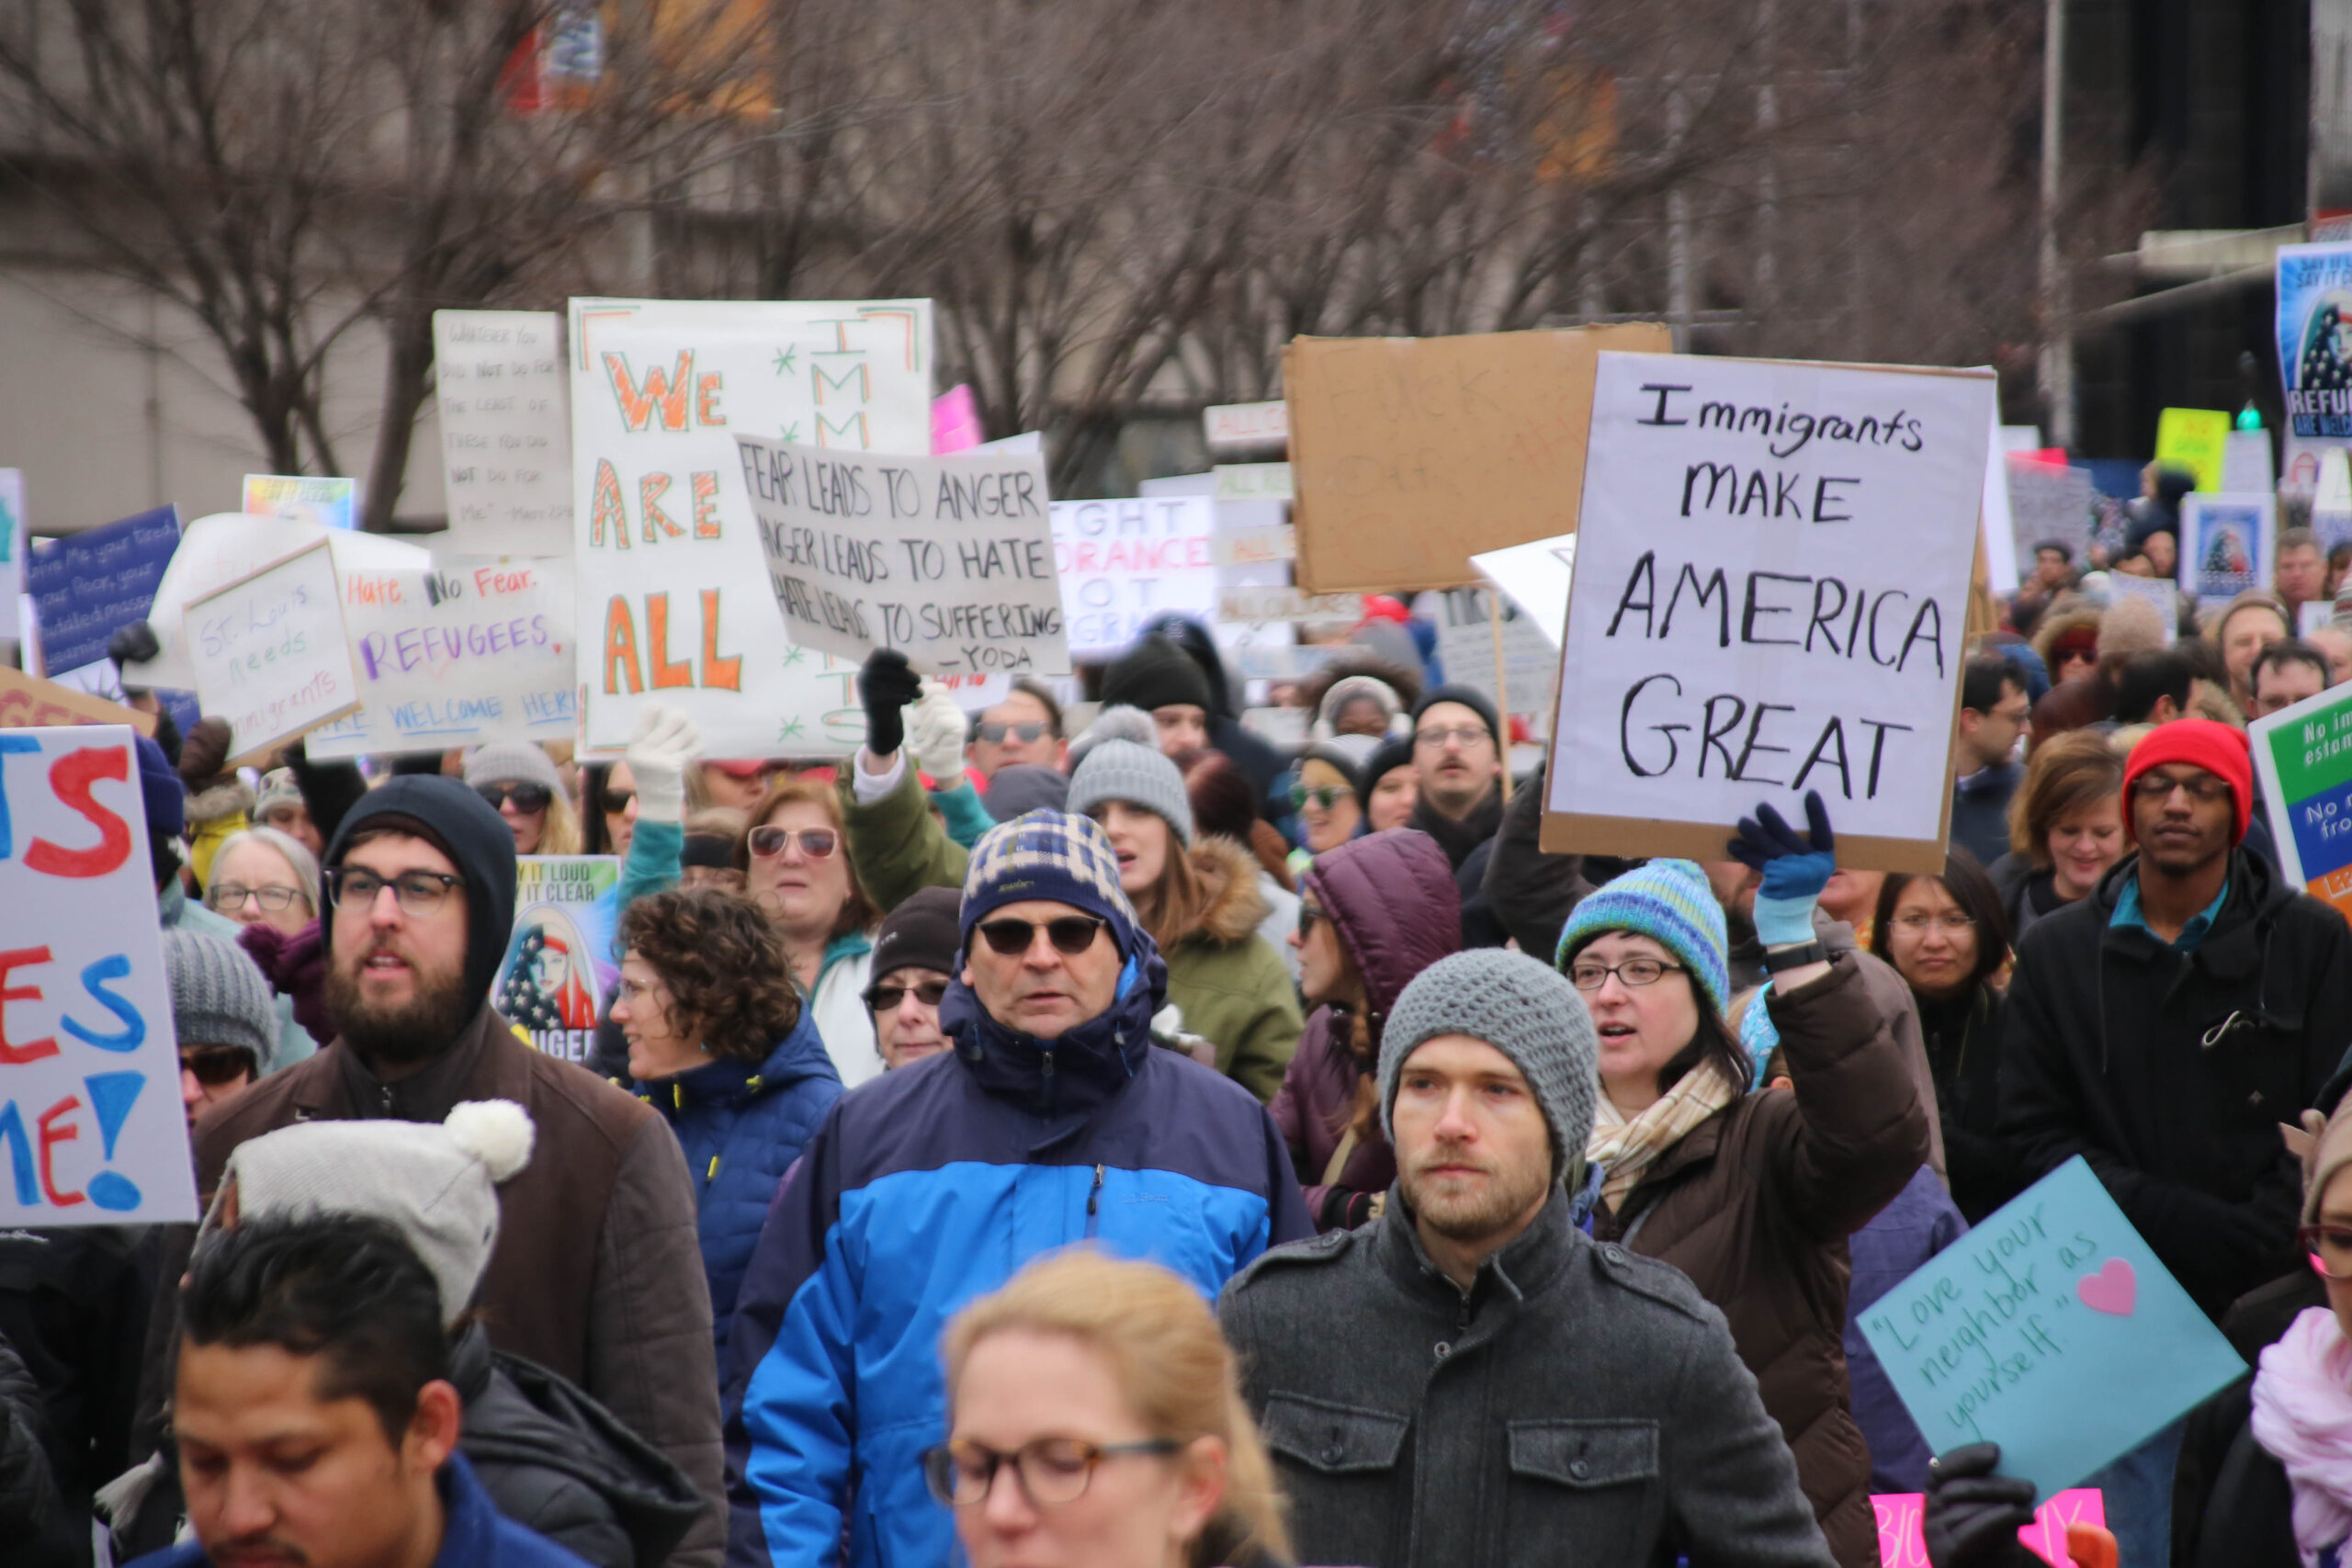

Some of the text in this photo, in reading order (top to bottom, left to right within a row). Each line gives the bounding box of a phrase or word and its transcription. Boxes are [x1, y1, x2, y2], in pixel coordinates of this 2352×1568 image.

[1636, 382, 1923, 459] Immigrants
[2290, 388, 2352, 414] REFU
[590, 457, 722, 551] ARE
[739, 443, 1041, 521] FEAR LEADS TO ANGER
[1680, 461, 1861, 523] MAKE
[822, 530, 890, 584] LEADS
[897, 538, 946, 582] TO
[956, 537, 1051, 580] HATE
[423, 570, 462, 607] No
[1606, 549, 1945, 680] AMERICA
[230, 624, 307, 685] needs
[359, 614, 548, 680] REFUGEES
[603, 587, 744, 695] ALL
[876, 603, 913, 649] TO
[919, 602, 1063, 642] SUFFERING
[231, 669, 337, 736] mmigrants
[388, 695, 503, 729] WELCOME
[2303, 720, 2325, 744] No
[1621, 672, 1914, 800] GREAT
[2305, 800, 2338, 825] No
[546, 882, 595, 902] CLEAR
[551, 863, 591, 882] LOUD
[1973, 1202, 2048, 1292] your
[1919, 1231, 2098, 1388] neighbor as
